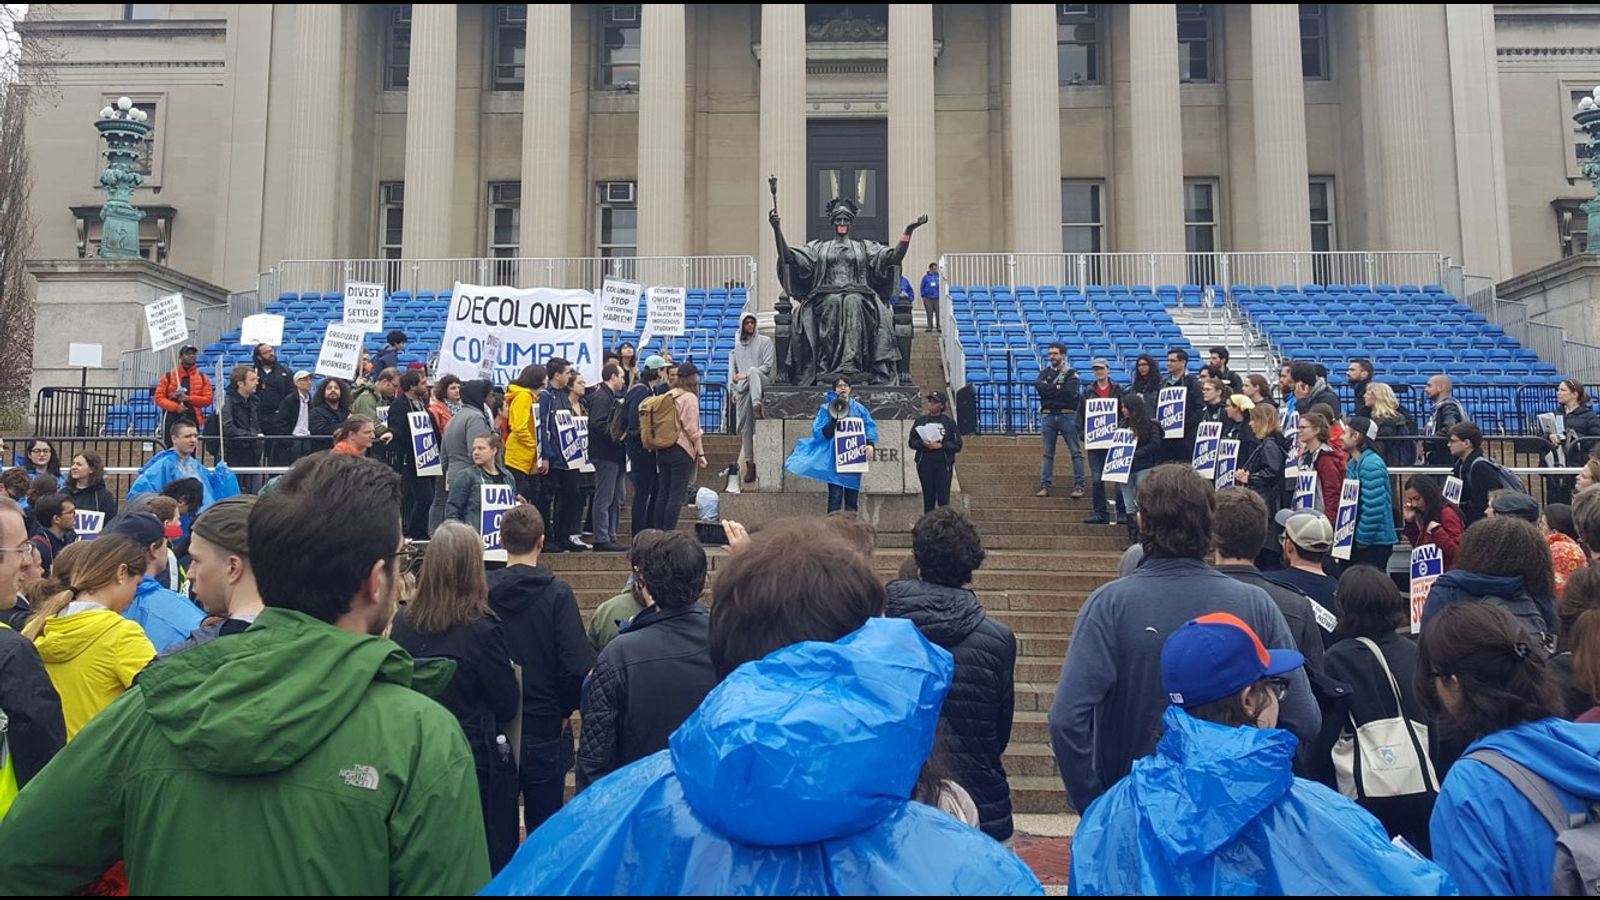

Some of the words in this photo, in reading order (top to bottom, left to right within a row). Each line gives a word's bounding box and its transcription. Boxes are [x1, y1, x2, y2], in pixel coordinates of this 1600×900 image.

[347, 287, 381, 298] DIVEST
[611, 296, 630, 306] STOP
[347, 309, 379, 318] SETTLER
[456, 295, 592, 330] DECOLONIZE
[328, 330, 360, 342] GRADUATE
[326, 340, 357, 351] STUDENTS
[453, 335, 592, 366] COUMBIA
[1161, 389, 1184, 402] UAW
[1088, 401, 1115, 412] UAW
[836, 420, 863, 432] UAW
[1094, 414, 1106, 429] ON
[1087, 423, 1117, 444] STRIKE
[1198, 425, 1219, 437] UAW
[845, 436, 857, 451] ON
[1113, 446, 1125, 460] ON
[1105, 456, 1131, 474] STRIKE
[1412, 546, 1438, 563] UAW
